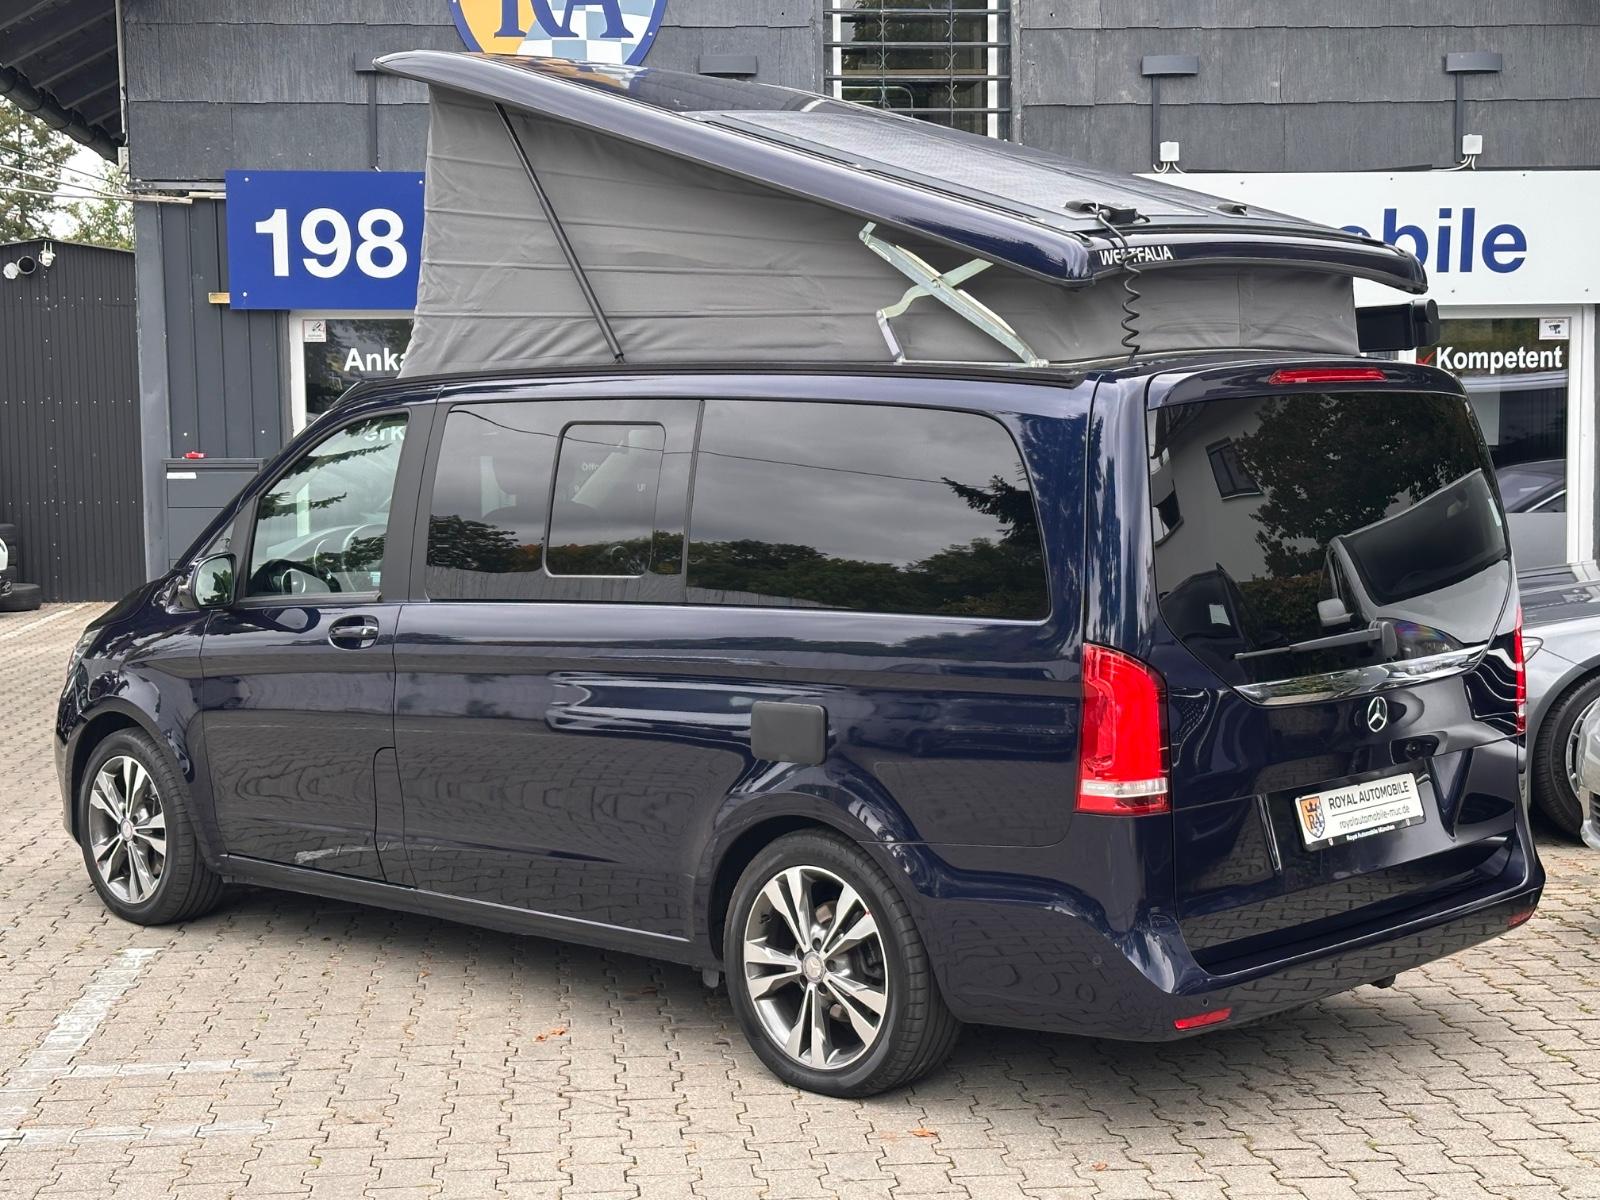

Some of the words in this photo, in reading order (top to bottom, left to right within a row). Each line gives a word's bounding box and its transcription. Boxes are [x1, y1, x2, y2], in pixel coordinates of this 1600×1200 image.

[255, 207, 408, 279] 198
[1340, 207, 1528, 274] bile
[1436, 347, 1563, 375] Kompetent
[1328, 793, 1358, 810] ROYAL
[1359, 781, 1409, 802] AUTOMOBILE
[1339, 804, 1410, 830] royalautomobile-muc.de
